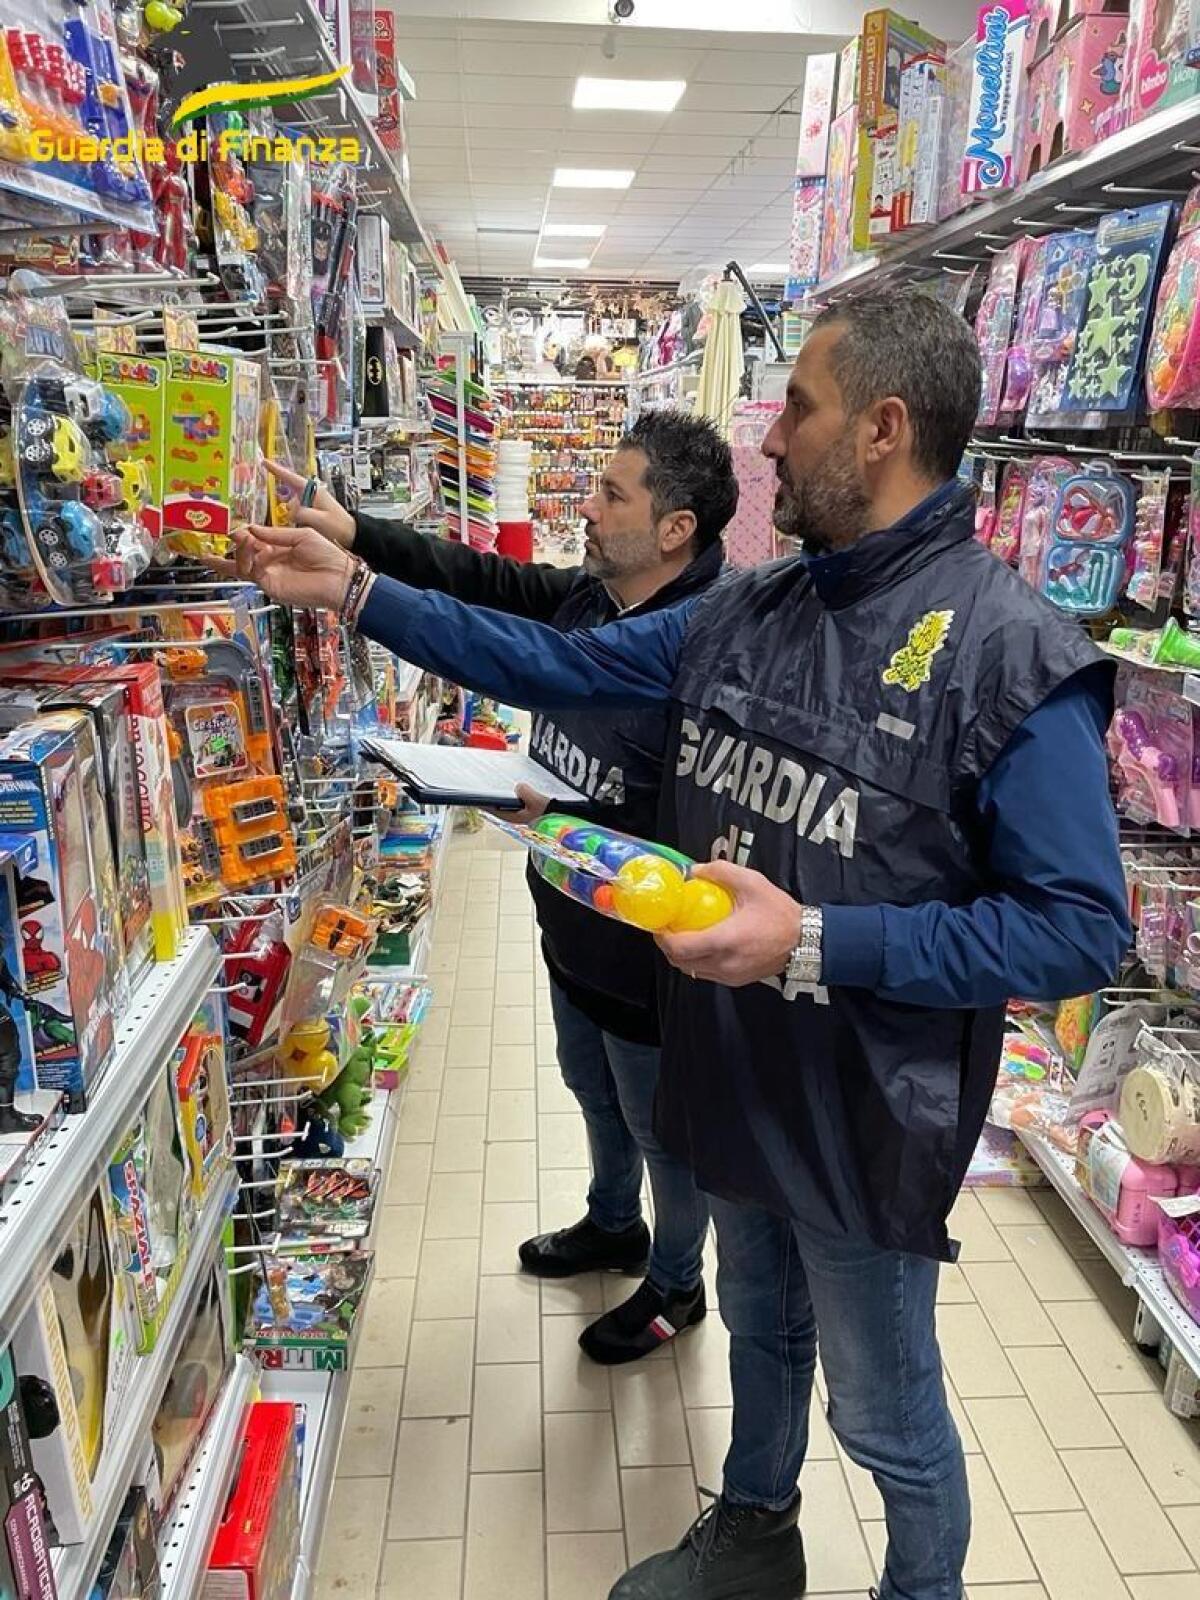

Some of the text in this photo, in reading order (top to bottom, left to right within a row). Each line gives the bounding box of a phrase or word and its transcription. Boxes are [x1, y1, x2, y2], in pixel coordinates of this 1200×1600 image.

[965, 6, 1010, 186] Monellini
[675, 717, 860, 859] GUARDIA
[710, 824, 755, 867] di
